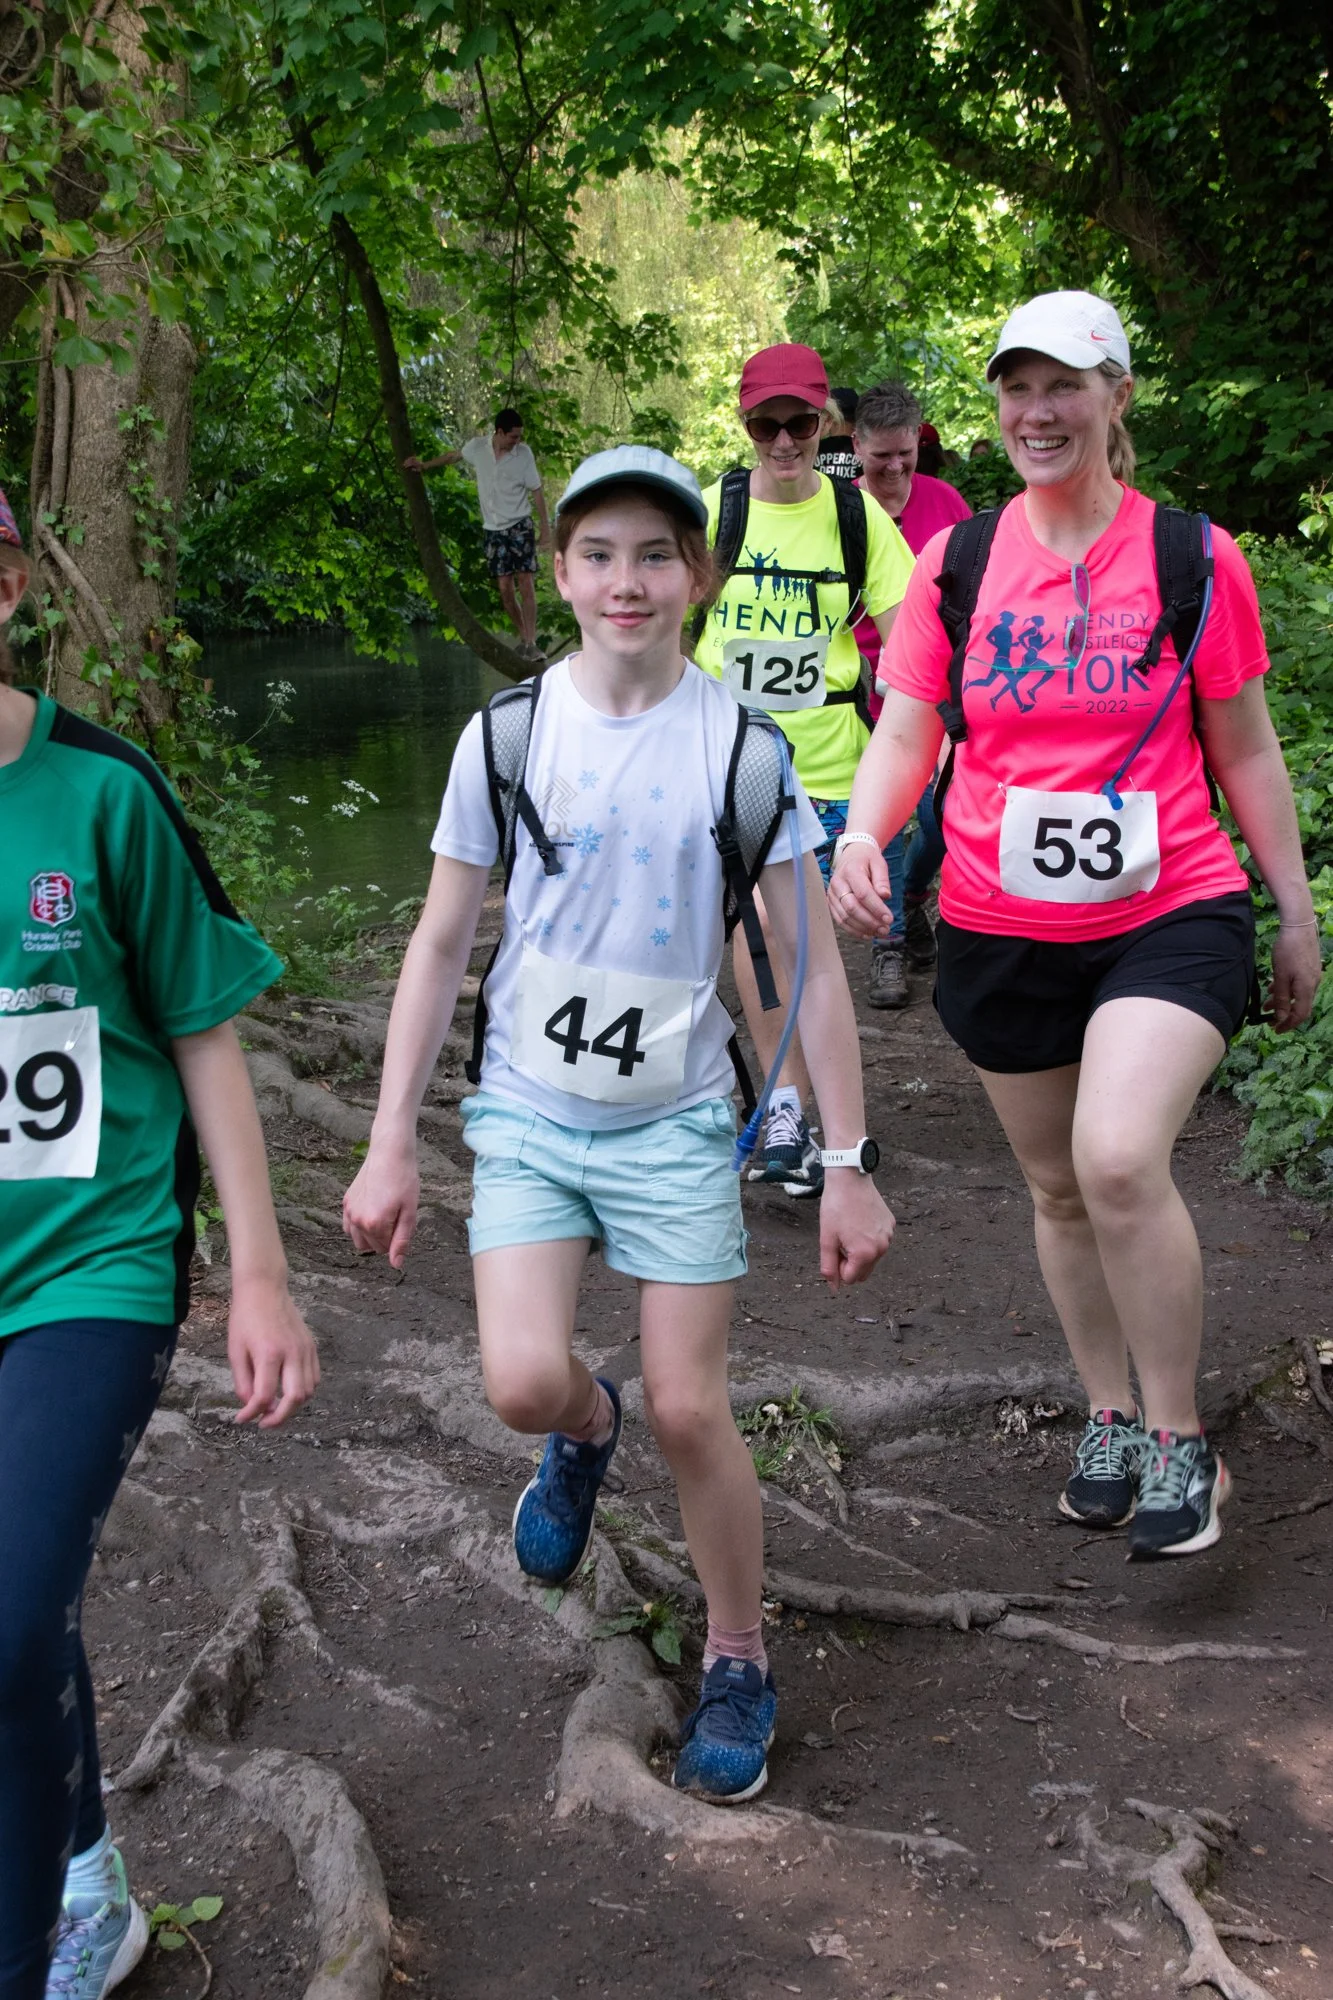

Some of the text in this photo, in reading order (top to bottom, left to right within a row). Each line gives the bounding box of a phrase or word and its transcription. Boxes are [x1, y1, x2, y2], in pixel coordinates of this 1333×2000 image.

[713, 601, 840, 643] HENDY
[1063, 635, 1149, 650] STLEIGH
[735, 651, 820, 696] 125
[1063, 654, 1151, 695] 10K
[1086, 700, 1128, 714] 2022
[1032, 817, 1124, 881] 53
[62, 940, 82, 950] Club
[544, 995, 646, 1077] 44
[0, 1051, 84, 1142] 9
